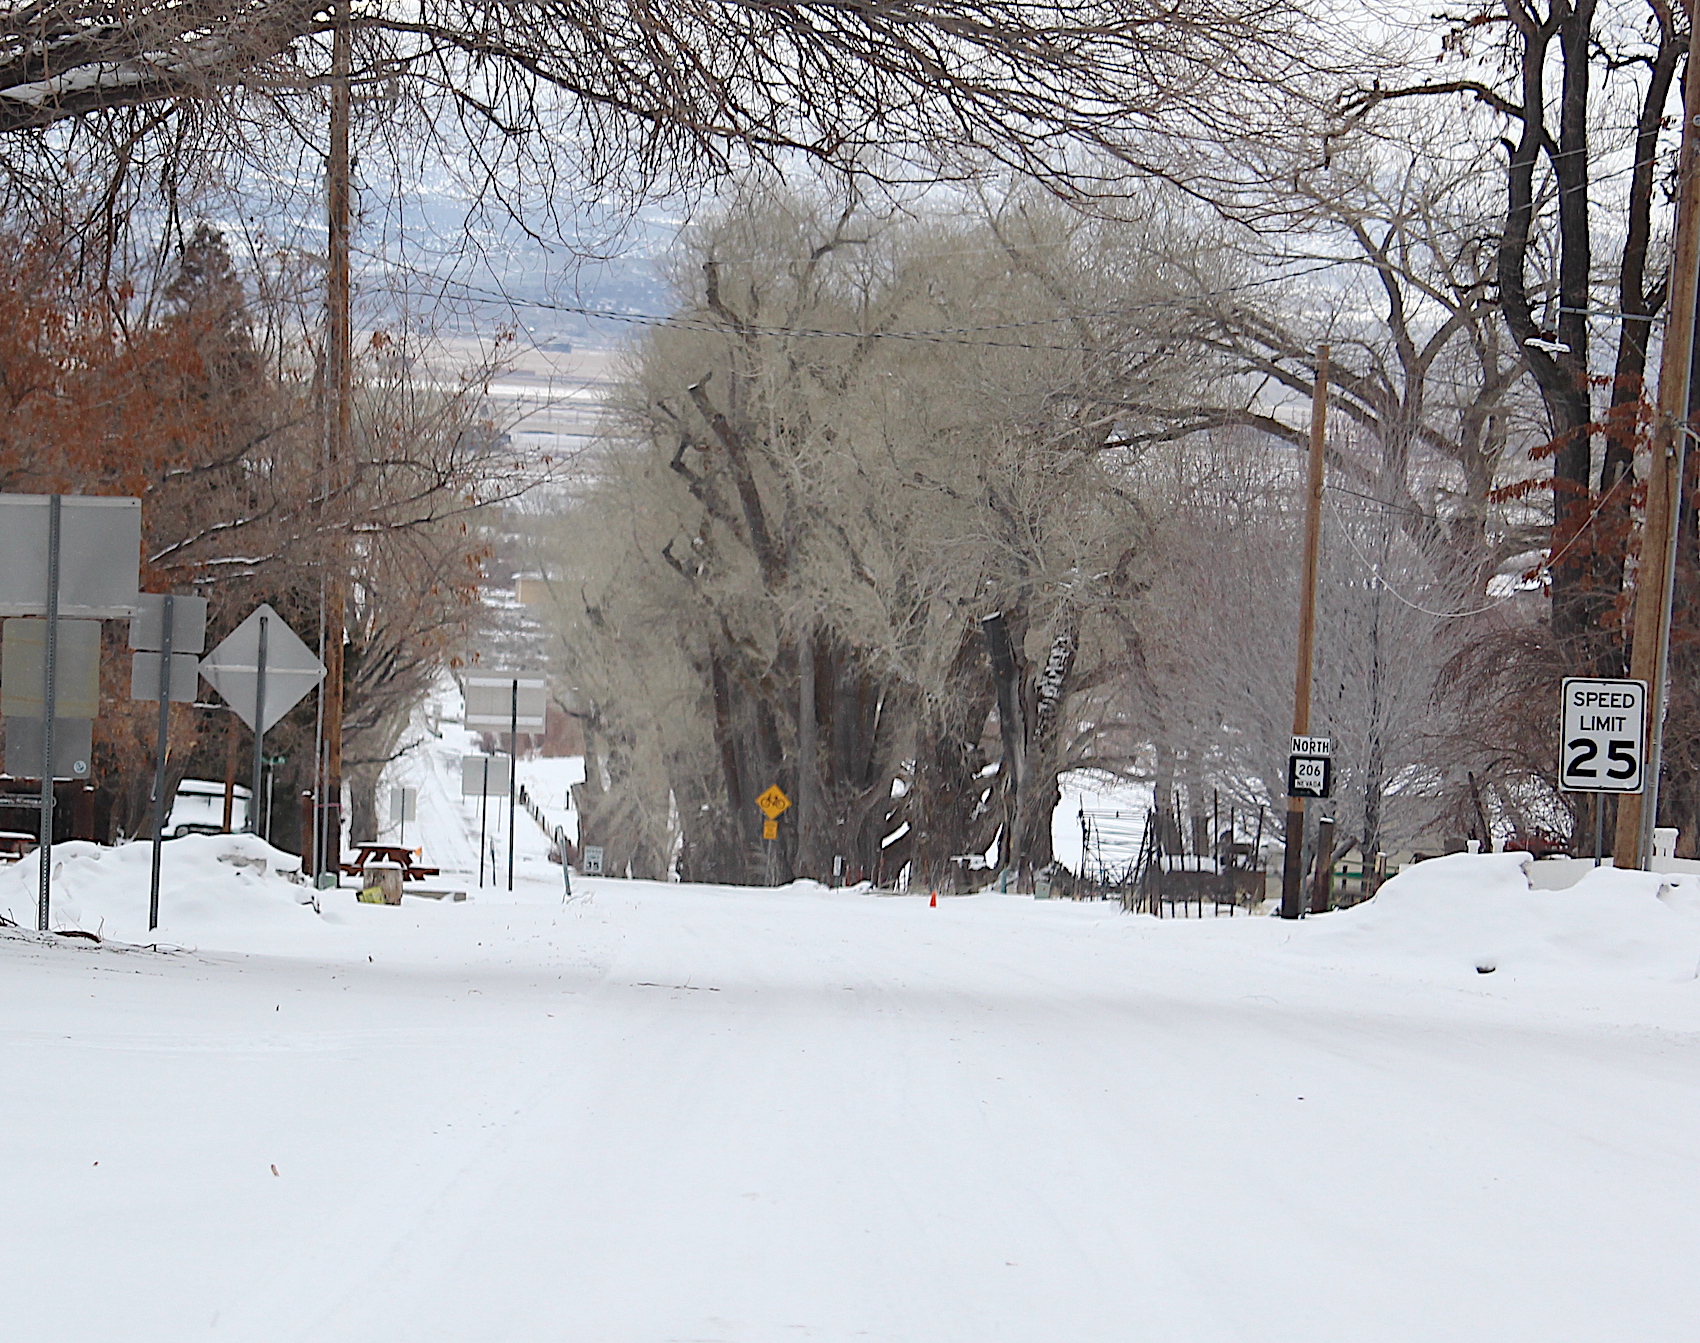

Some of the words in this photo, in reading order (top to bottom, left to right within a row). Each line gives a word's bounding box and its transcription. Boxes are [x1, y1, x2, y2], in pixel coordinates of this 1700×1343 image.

[1573, 691, 1635, 709] SPEED
[1580, 715, 1626, 732] LIMIT
[1292, 738, 1329, 753] NORTH
[1566, 738, 1637, 780] 25
[1299, 764, 1321, 777] 206
